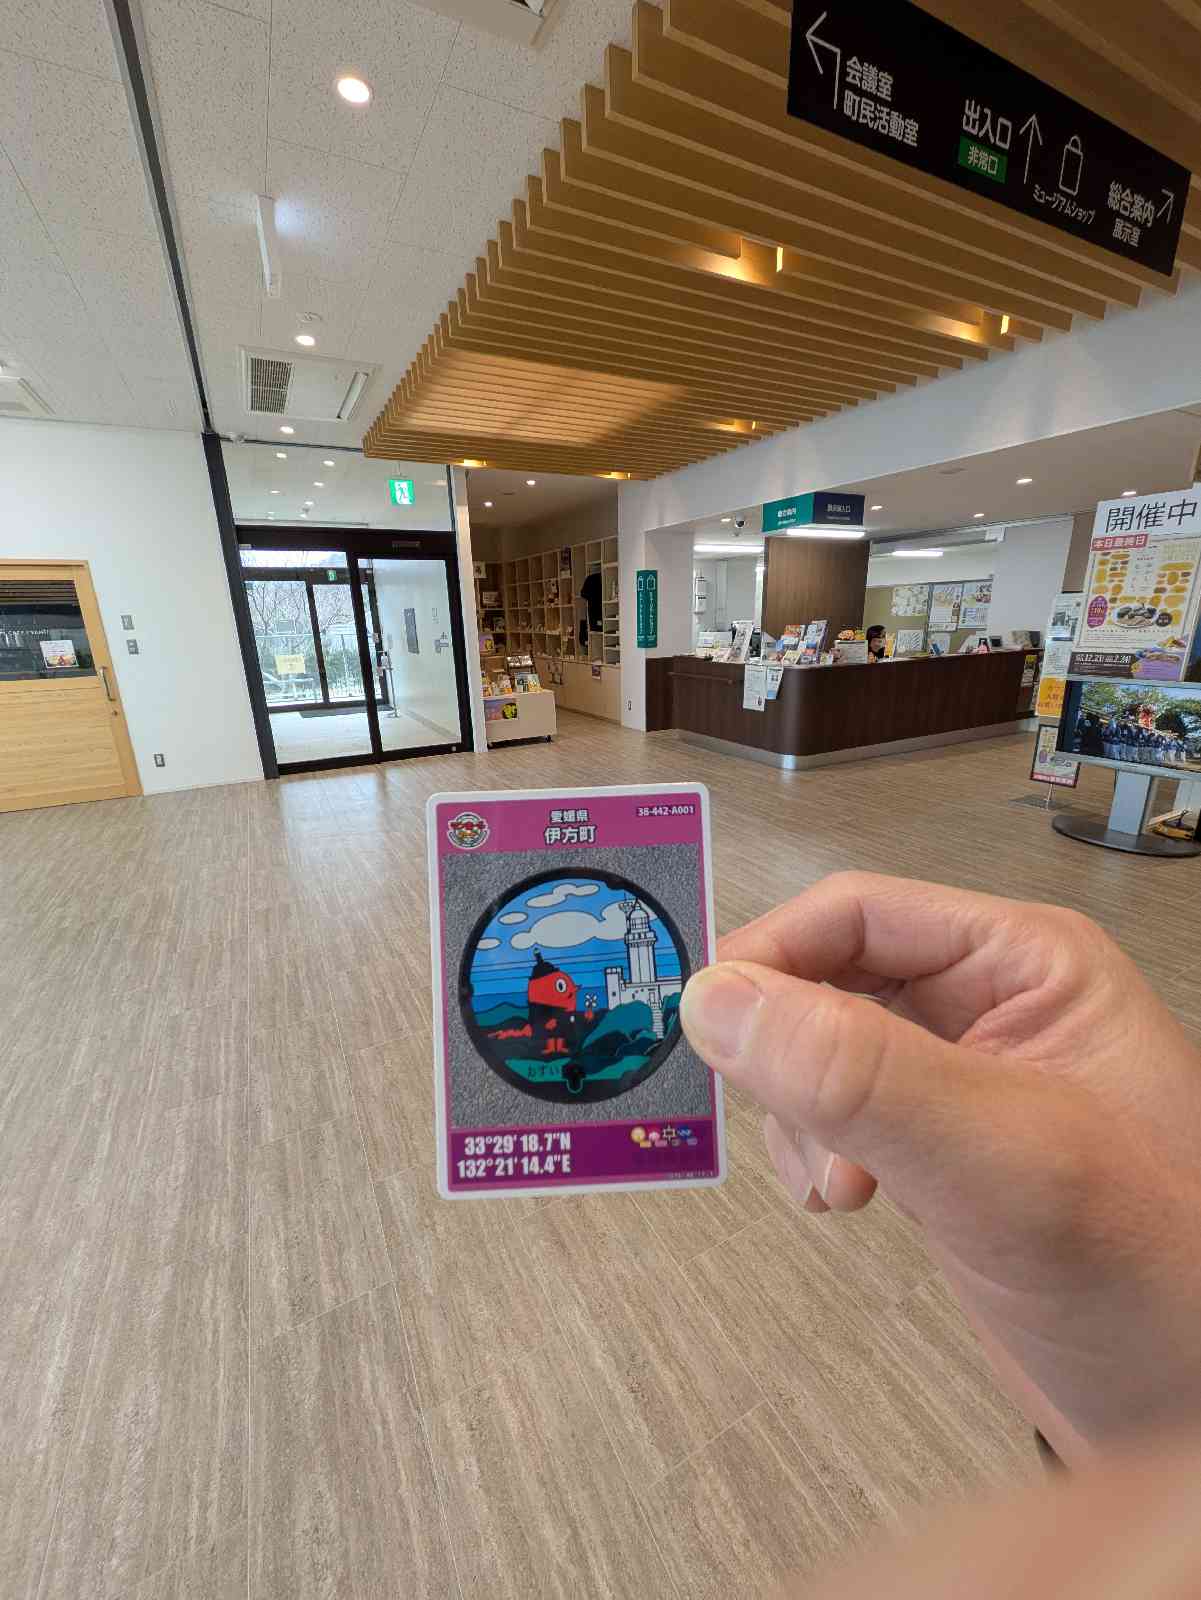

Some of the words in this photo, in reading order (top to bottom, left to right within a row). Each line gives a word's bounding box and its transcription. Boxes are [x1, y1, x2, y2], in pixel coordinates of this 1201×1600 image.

[846, 56, 894, 101] 会議室
[843, 89, 919, 148] 町民活動室
[962, 99, 1013, 150] 出入口
[967, 145, 999, 176] 非常口
[1033, 184, 1096, 224] ミュージアムショップ
[1107, 181, 1155, 227] 総合案内
[1112, 218, 1141, 247] 展示室
[1105, 498, 1198, 533] 開催中
[550, 809, 589, 823] 愛媛県
[637, 805, 694, 817] 38-442-A001
[544, 825, 596, 845] 伊方町
